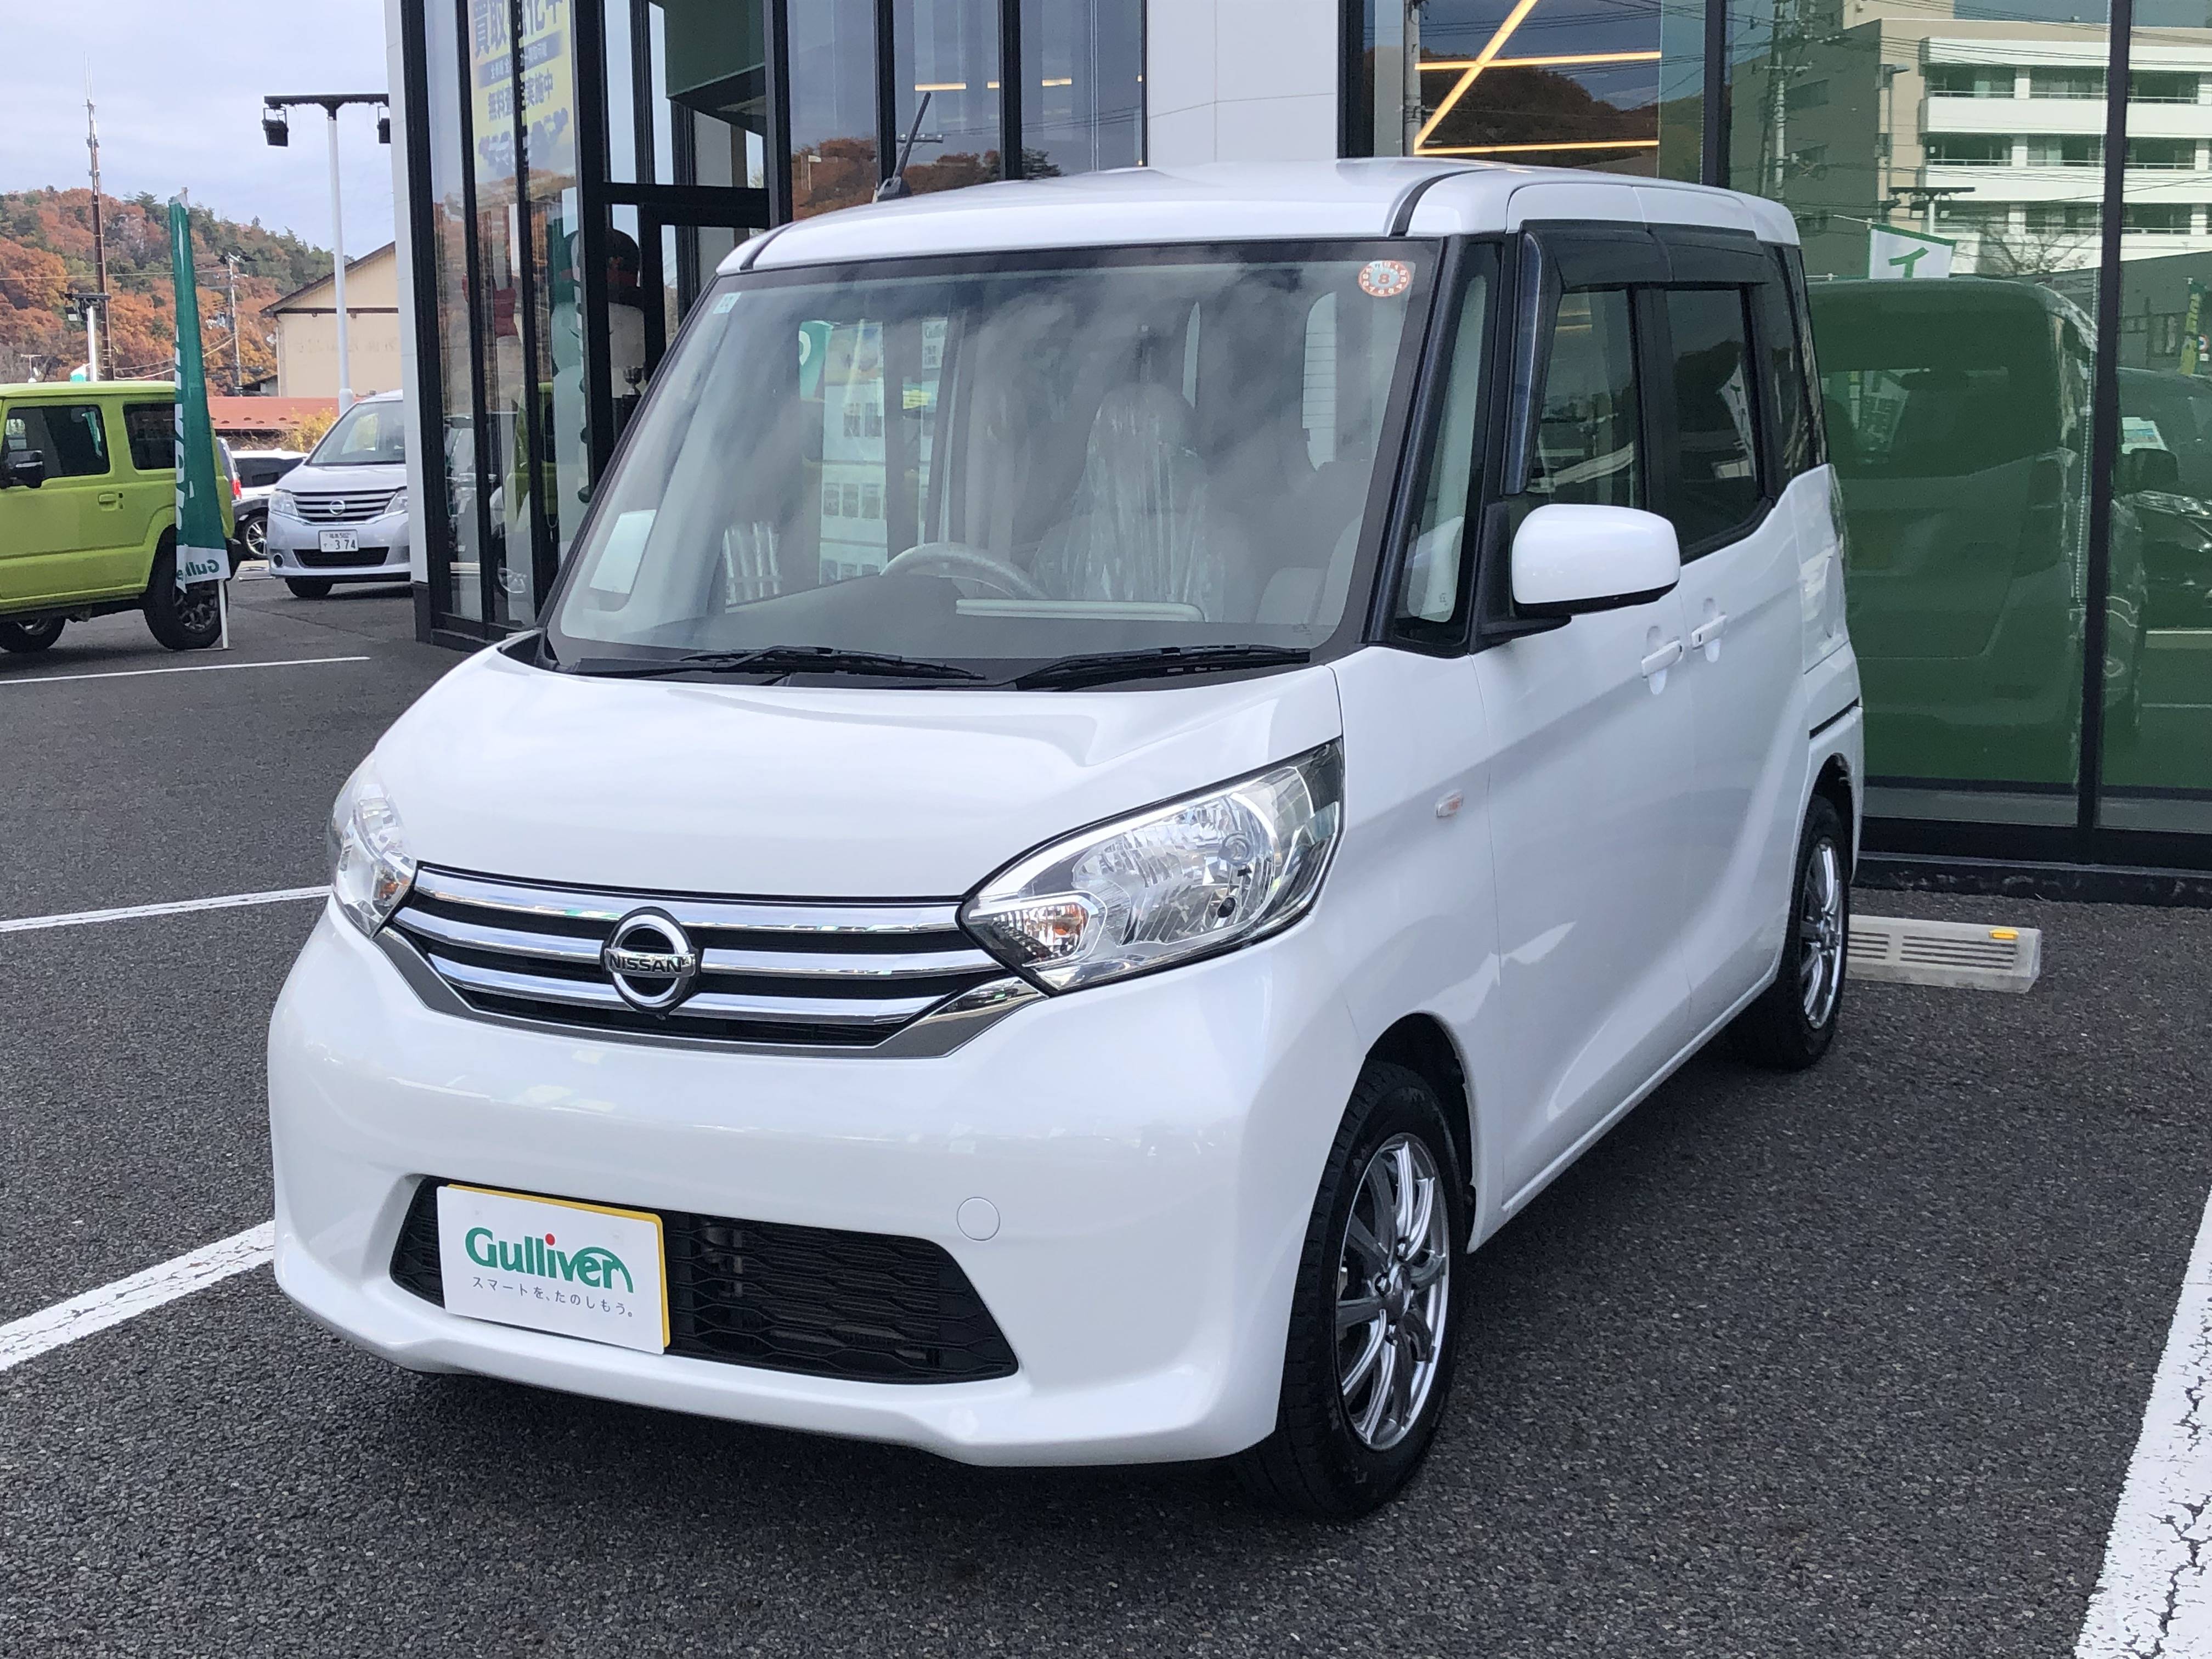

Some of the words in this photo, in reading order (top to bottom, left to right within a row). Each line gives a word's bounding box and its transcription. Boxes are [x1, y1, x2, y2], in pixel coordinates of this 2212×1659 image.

[1378, 274, 1390, 284] 8
[1888, 247, 1929, 279] イ
[610, 954, 682, 973] NISSAN
[465, 1227, 634, 1294] Gulliver
[472, 1276, 633, 1317] スマートを、たのしもう。
